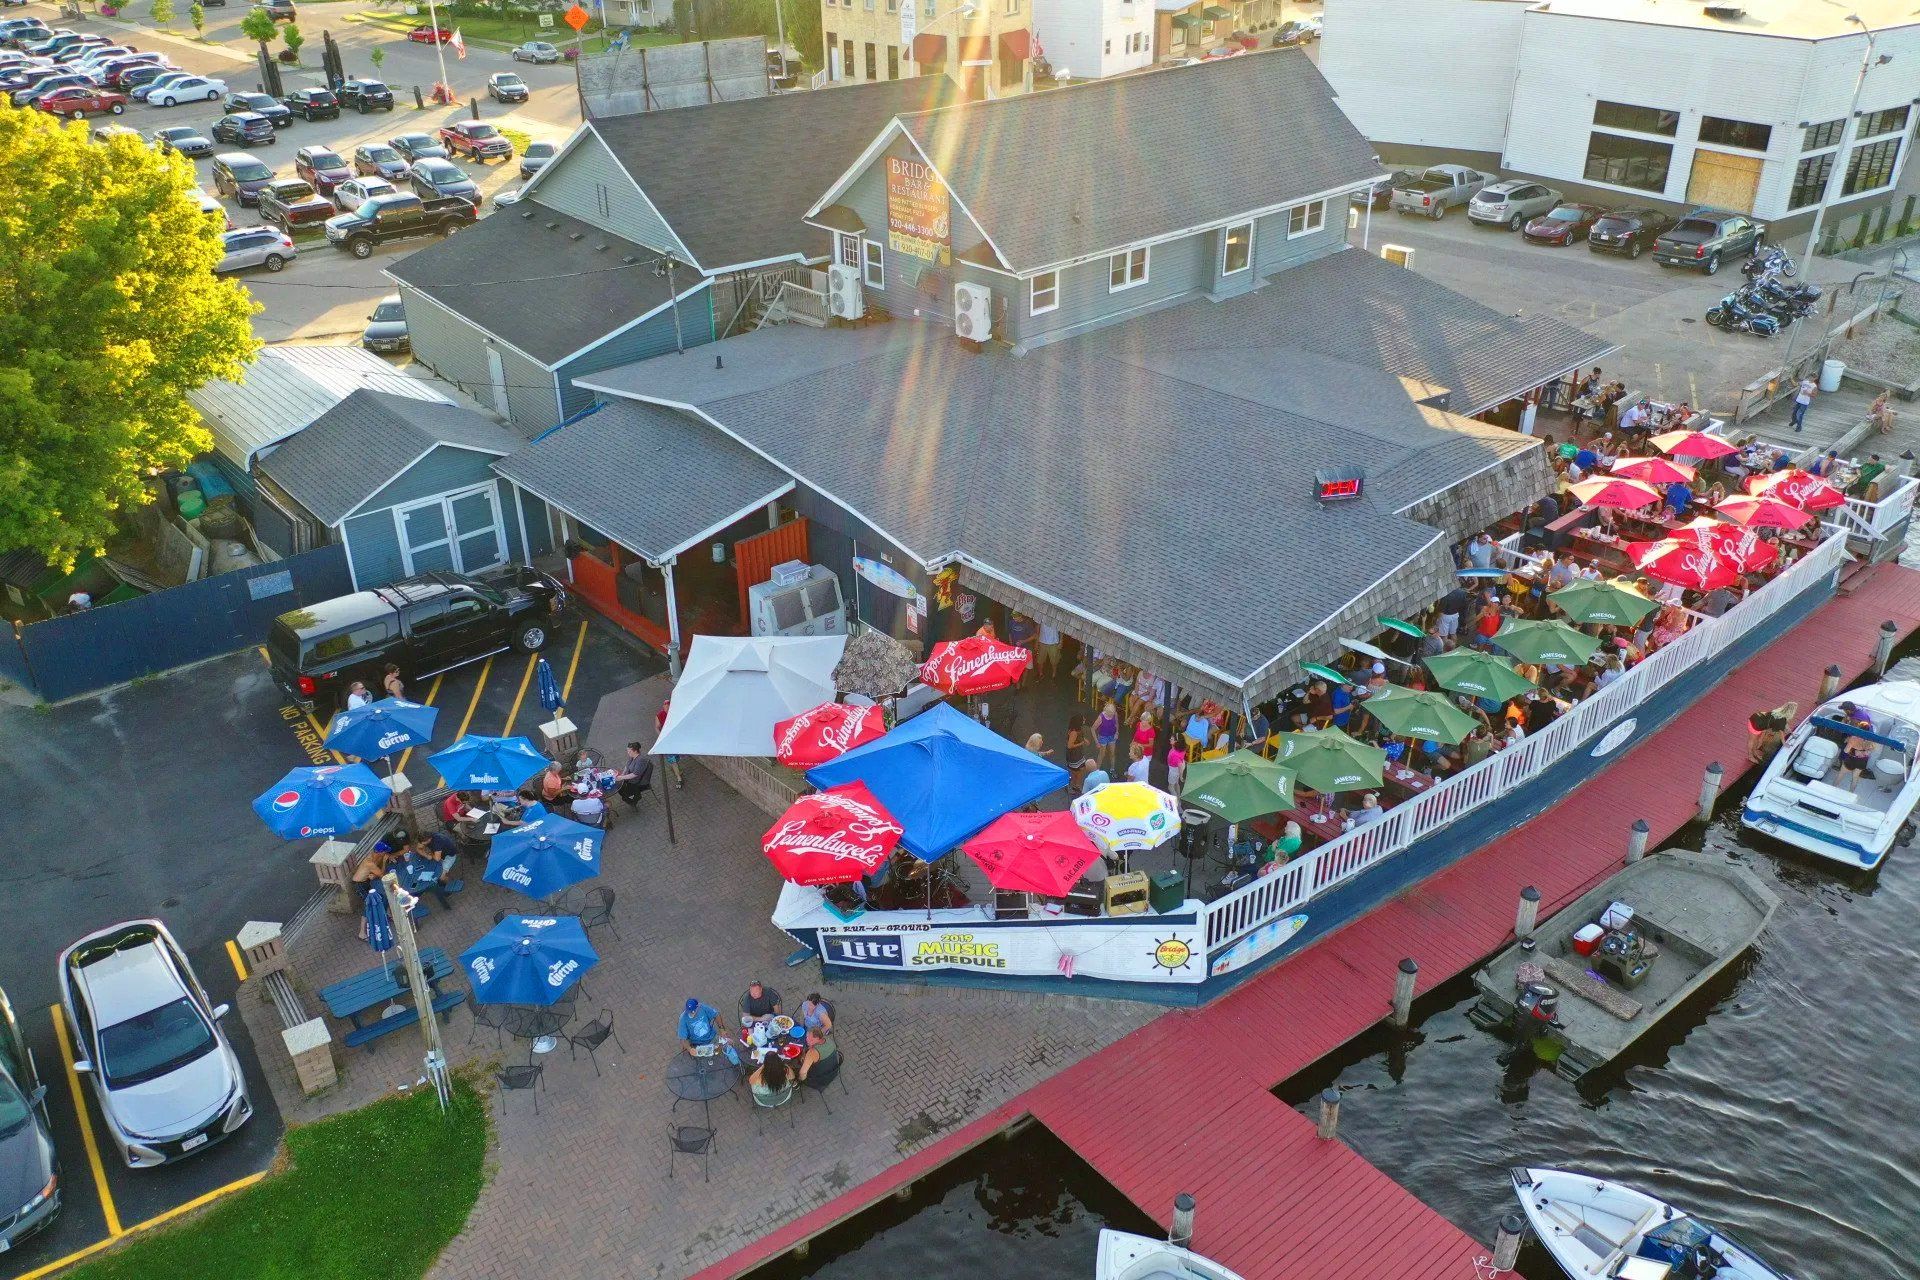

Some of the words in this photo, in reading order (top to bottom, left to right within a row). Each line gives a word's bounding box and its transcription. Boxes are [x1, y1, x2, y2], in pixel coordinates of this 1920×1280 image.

[904, 178, 924, 190] BAR
[892, 184, 946, 205] RESTAURANT
[890, 218, 934, 237] 920-446-3300
[1321, 480, 1357, 496] OPEN
[1588, 612, 1617, 620] JAMESON
[1540, 652, 1567, 660] JAMESON
[1457, 682, 1487, 692] JAMESON
[278, 704, 300, 721] NO
[290, 720, 333, 766] PARKING
[1410, 727, 1440, 736] JAMESON
[378, 733, 411, 750] Cuervo
[1333, 775, 1362, 785] JAMESON
[1199, 794, 1226, 808] JAMESON
[313, 826, 335, 834] pepsi
[577, 837, 594, 861] Cuervo
[517, 864, 530, 874] Jose
[1063, 858, 1086, 882] BACARDI
[502, 867, 532, 888] Cuervo
[843, 924, 930, 932] RUN-A-GROUND
[941, 933, 974, 943] 2019
[840, 940, 900, 960] Lite
[917, 941, 999, 957] MUSIC
[1159, 945, 1186, 953] Bridge
[911, 955, 1006, 968] SCHEDULE
[471, 956, 491, 984] Cuervo
[548, 959, 580, 987] Cuervo
